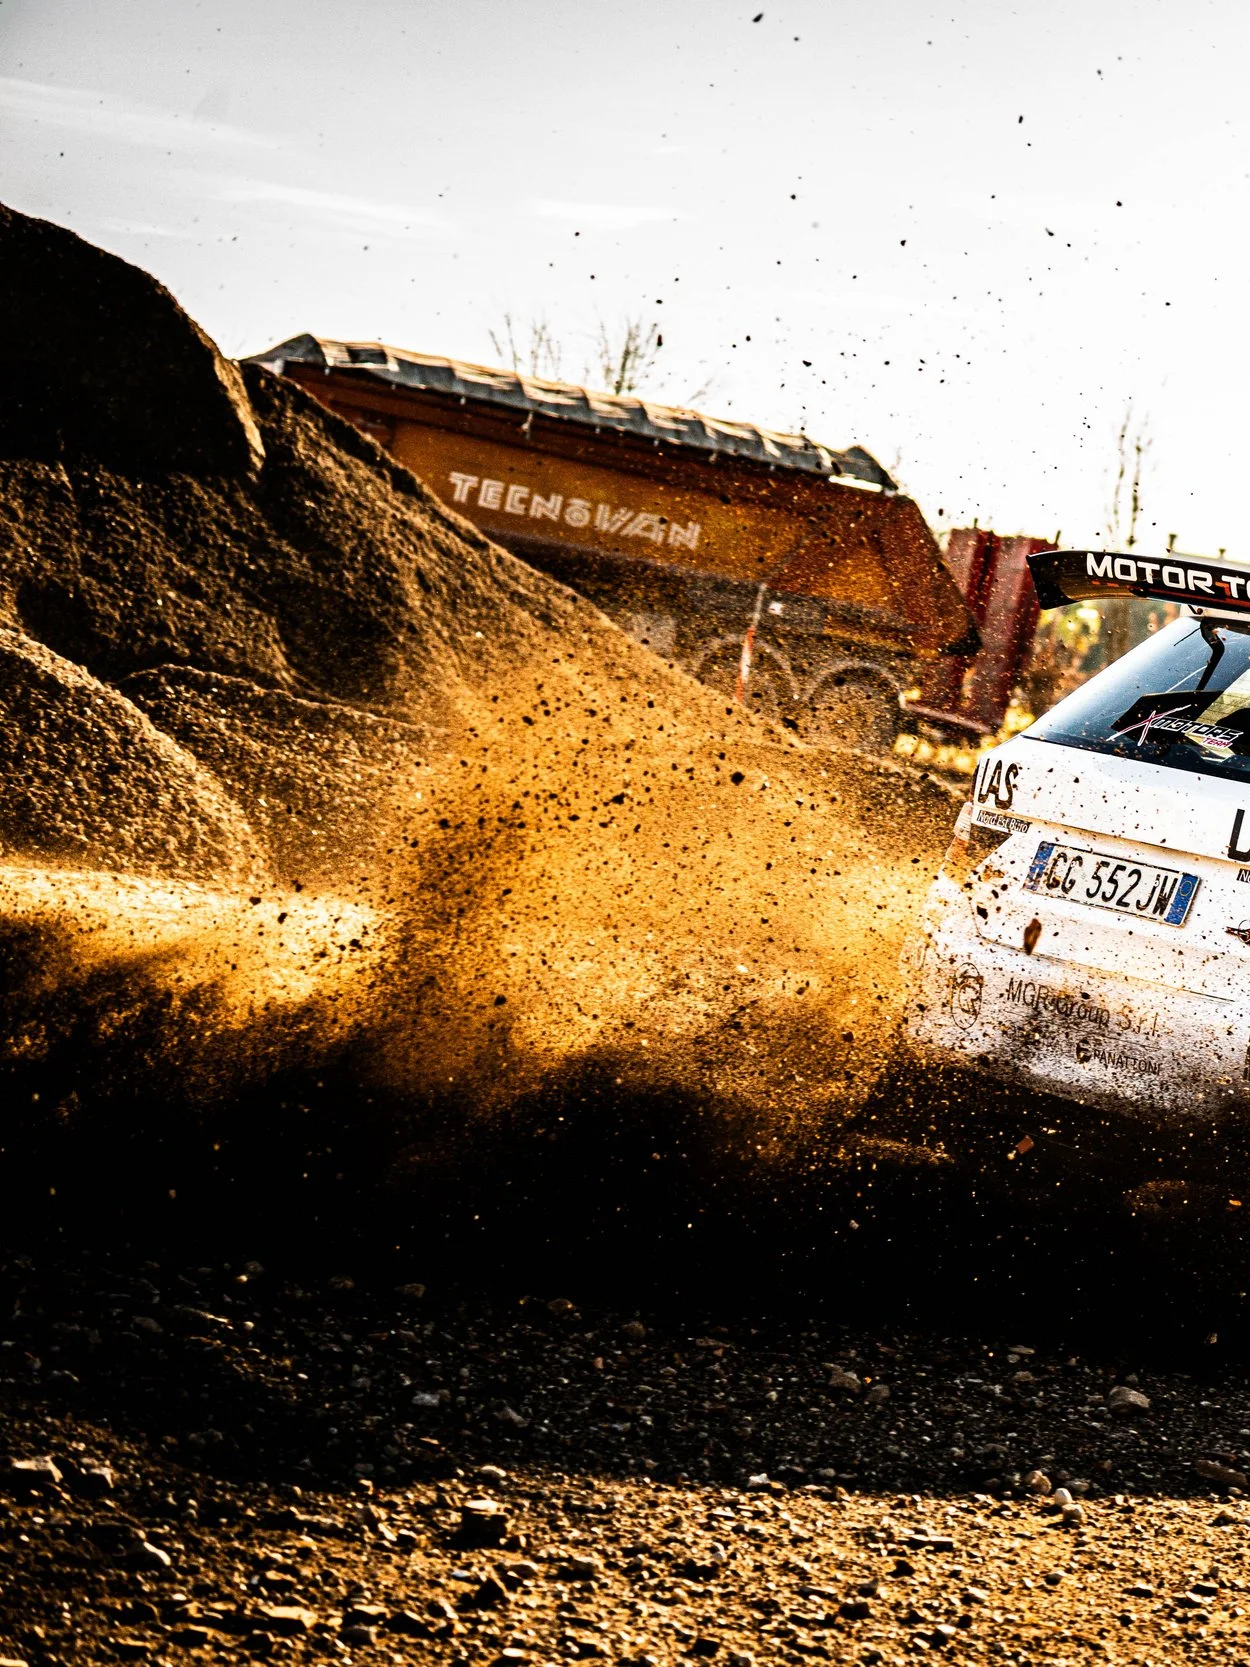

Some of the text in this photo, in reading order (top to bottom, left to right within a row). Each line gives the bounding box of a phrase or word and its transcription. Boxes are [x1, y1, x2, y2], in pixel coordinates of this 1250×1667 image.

[1086, 552, 1215, 594] MOTOR
[1203, 737, 1233, 748] TEAM
[977, 758, 1019, 810] LAS
